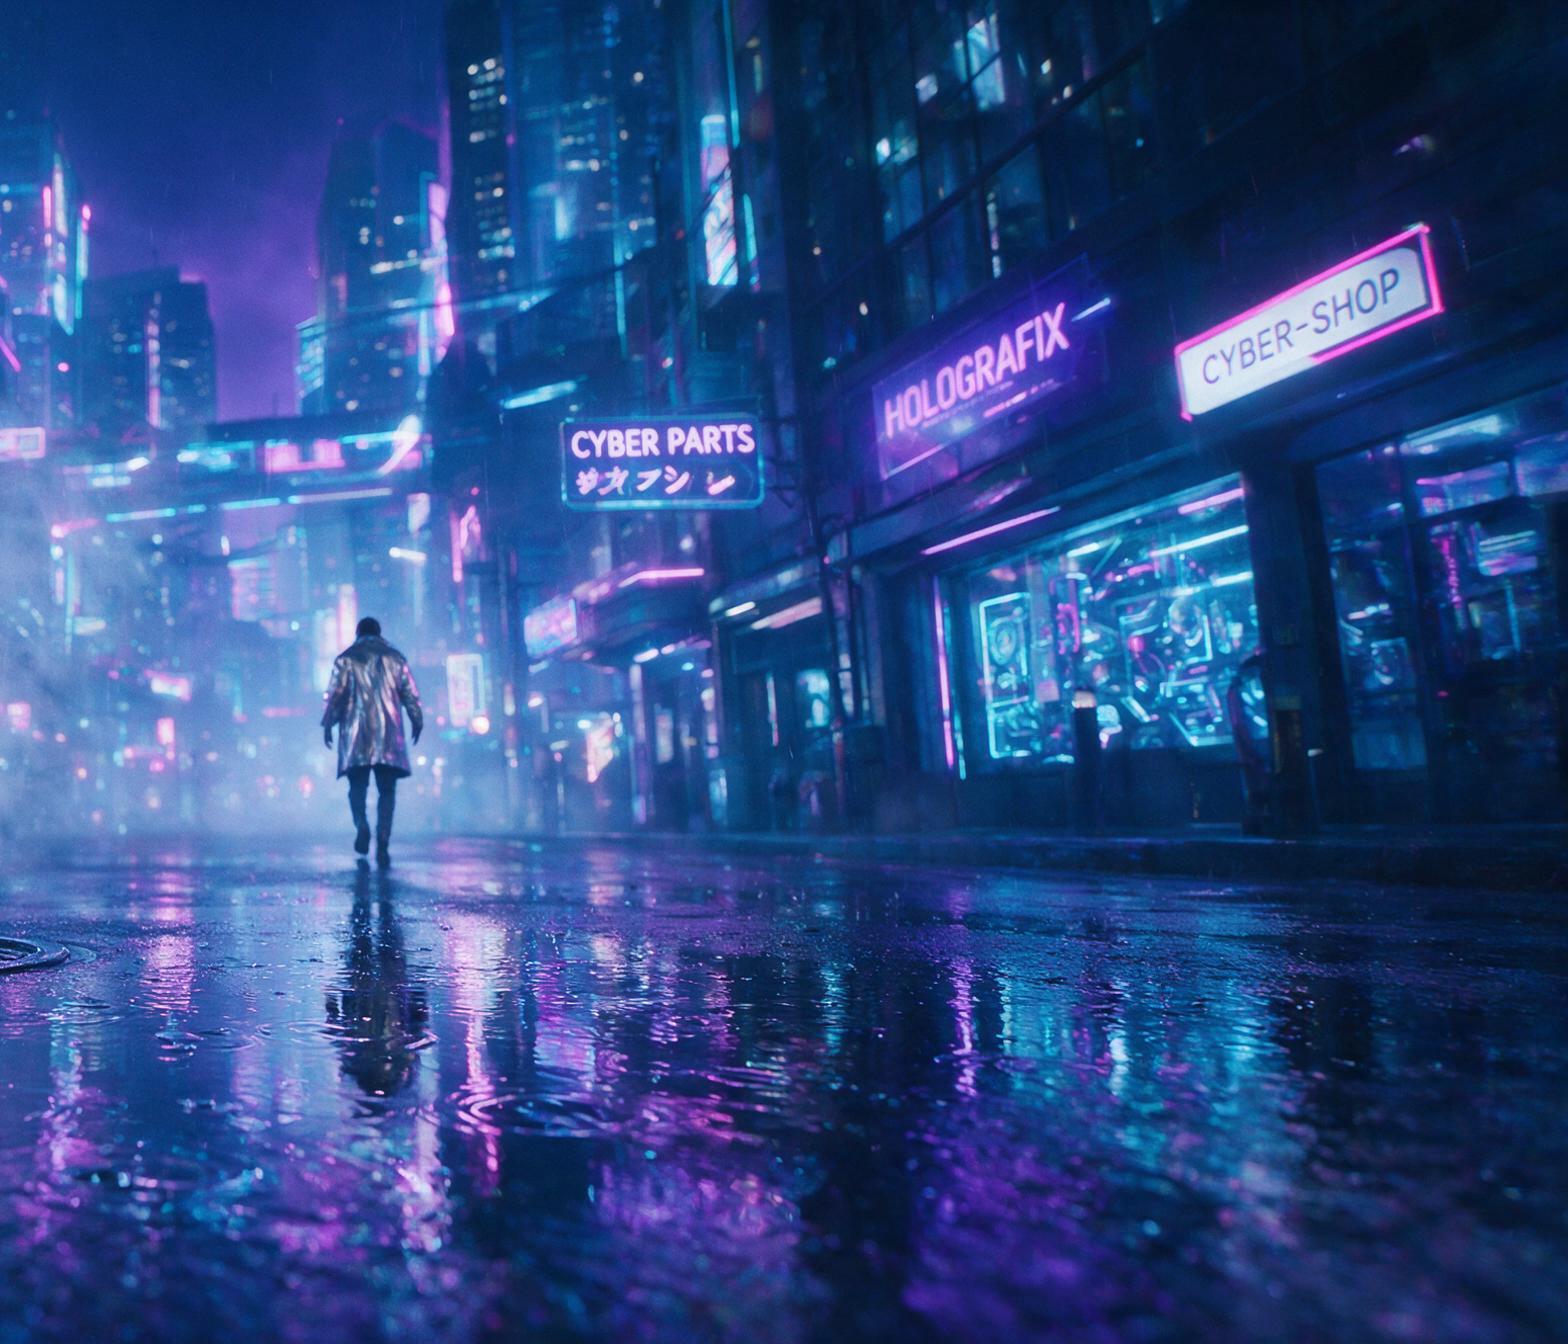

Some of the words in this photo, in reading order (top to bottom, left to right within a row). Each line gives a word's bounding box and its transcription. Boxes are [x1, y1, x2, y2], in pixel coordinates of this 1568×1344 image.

[885, 303, 1070, 439] HOLOGRAFIX
[1202, 267, 1400, 385] CYBER-SHOP
[571, 428, 661, 458] CYBER
[667, 423, 756, 455] PARTS
